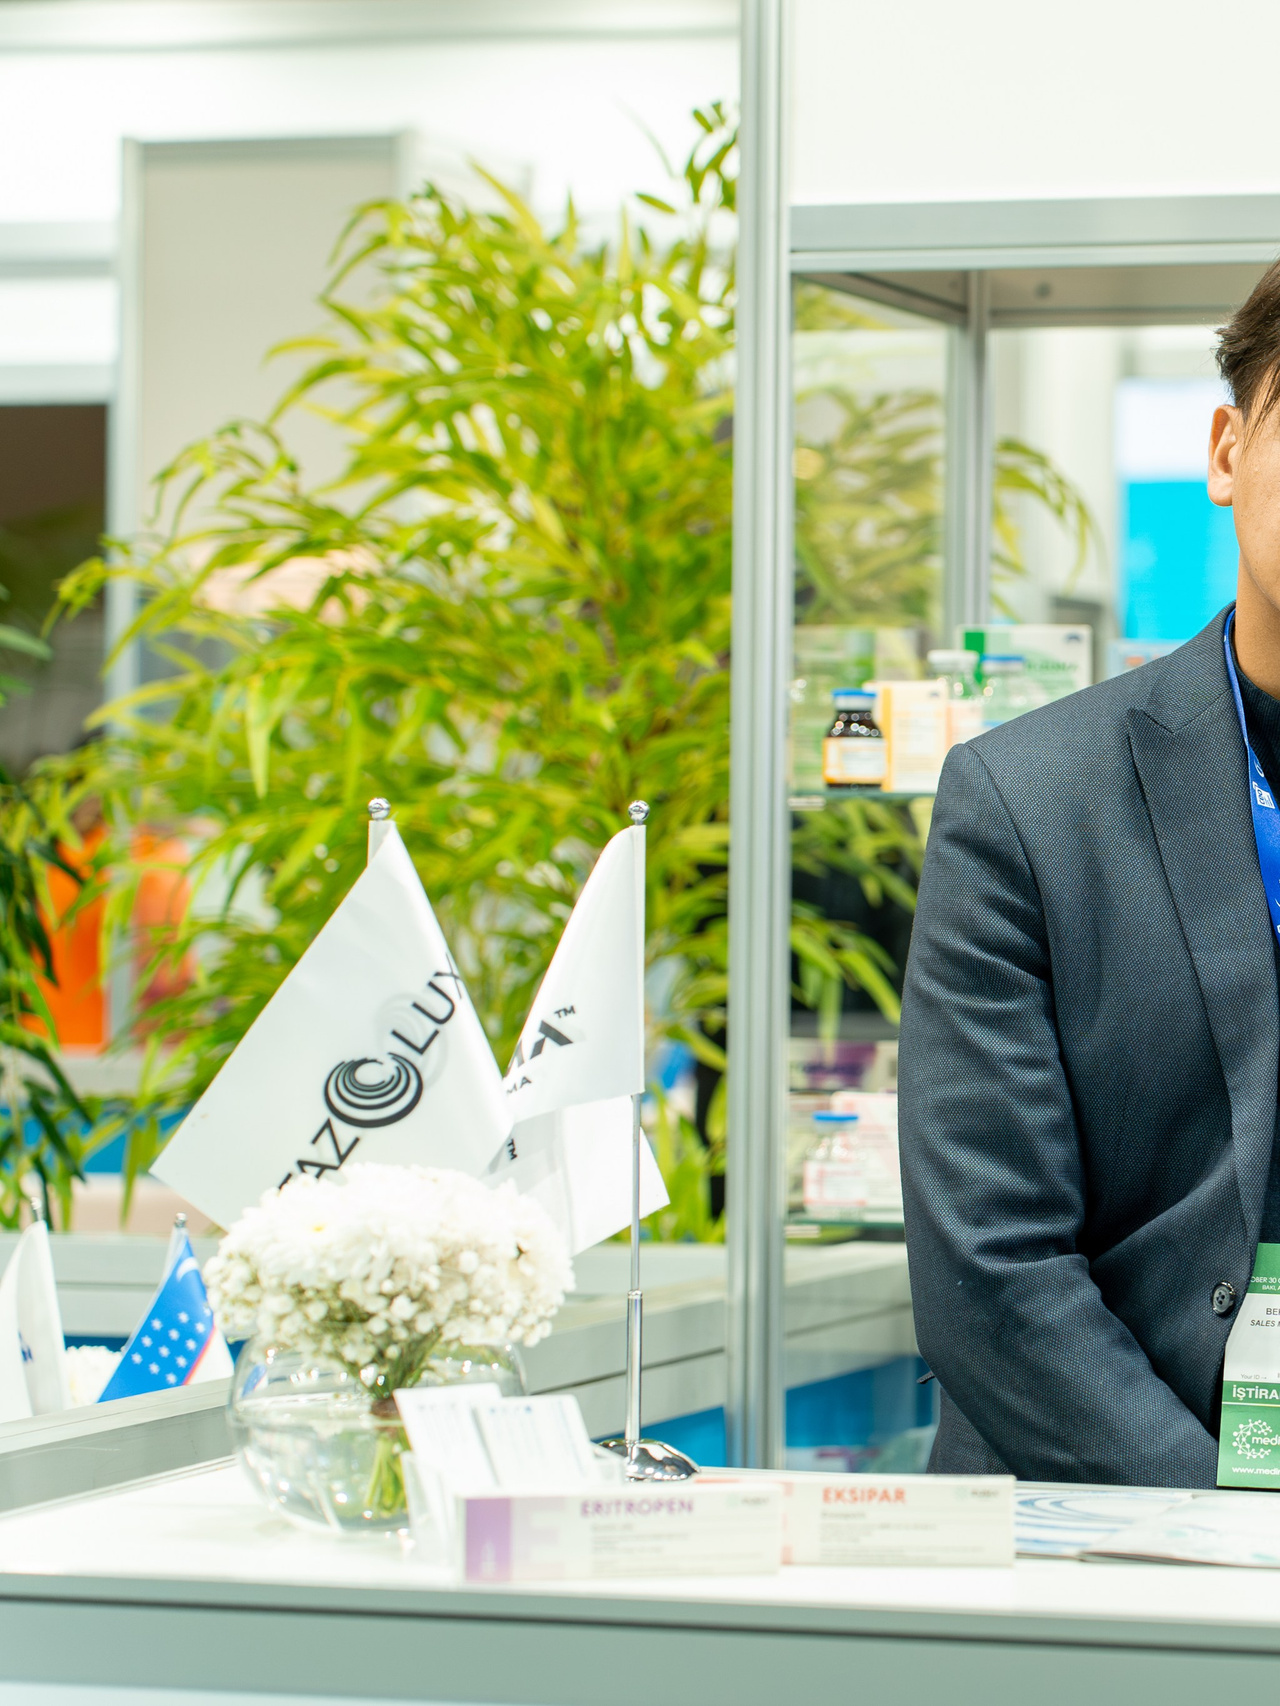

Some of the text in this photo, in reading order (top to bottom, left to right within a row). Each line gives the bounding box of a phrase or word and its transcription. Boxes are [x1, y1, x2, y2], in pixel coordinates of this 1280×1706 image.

[1250, 1319, 1276, 1328] SALES
[823, 1487, 906, 1504] EKSIPAR
[580, 1497, 694, 1517] ERITROPEN
